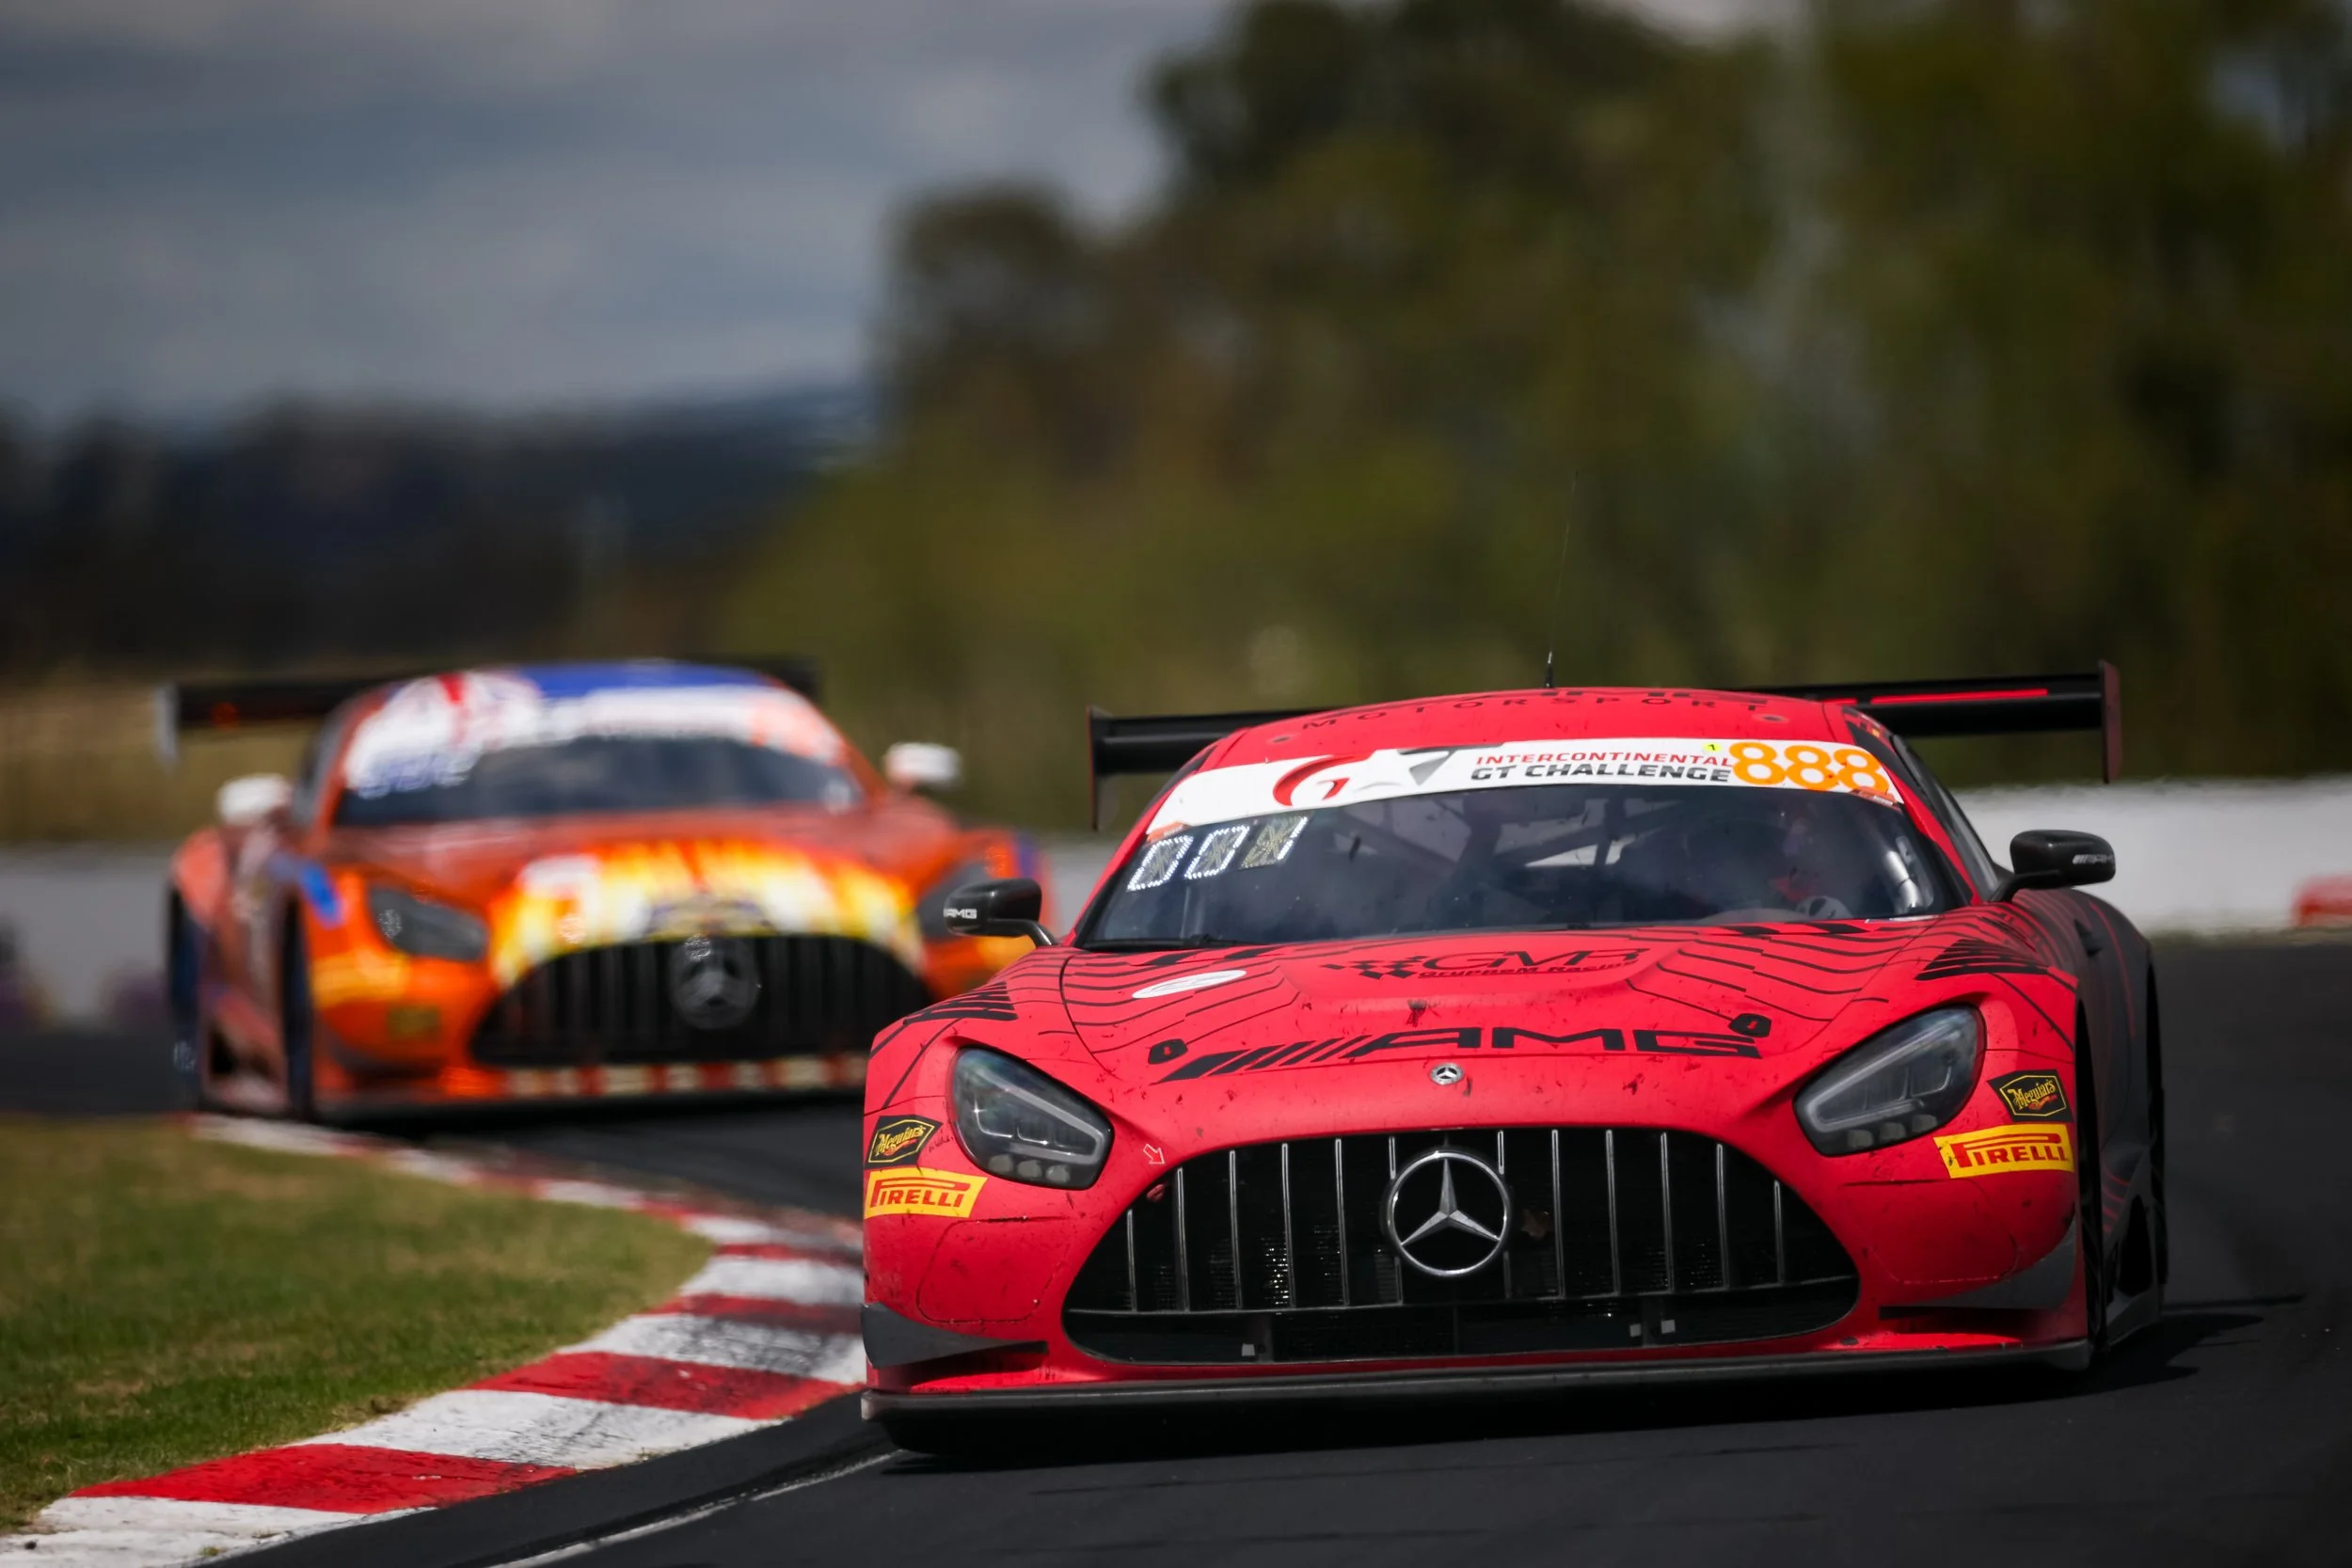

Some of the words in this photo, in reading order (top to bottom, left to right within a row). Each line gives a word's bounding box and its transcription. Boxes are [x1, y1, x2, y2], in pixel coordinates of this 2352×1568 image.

[1471, 765, 1517, 781] GT
[1525, 764, 1731, 783] CHALLENGE
[1476, 752, 1733, 767] INTERCONTINENTAL
[1728, 741, 1889, 792] 888
[945, 908, 977, 920] AMG
[1338, 1027, 1763, 1060] AMG
[2007, 1078, 2057, 1111] Meguiar's
[874, 1125, 927, 1158] Meguiar's
[1949, 1132, 2069, 1169] PIRELLI
[869, 1177, 971, 1209] PIRELLI
